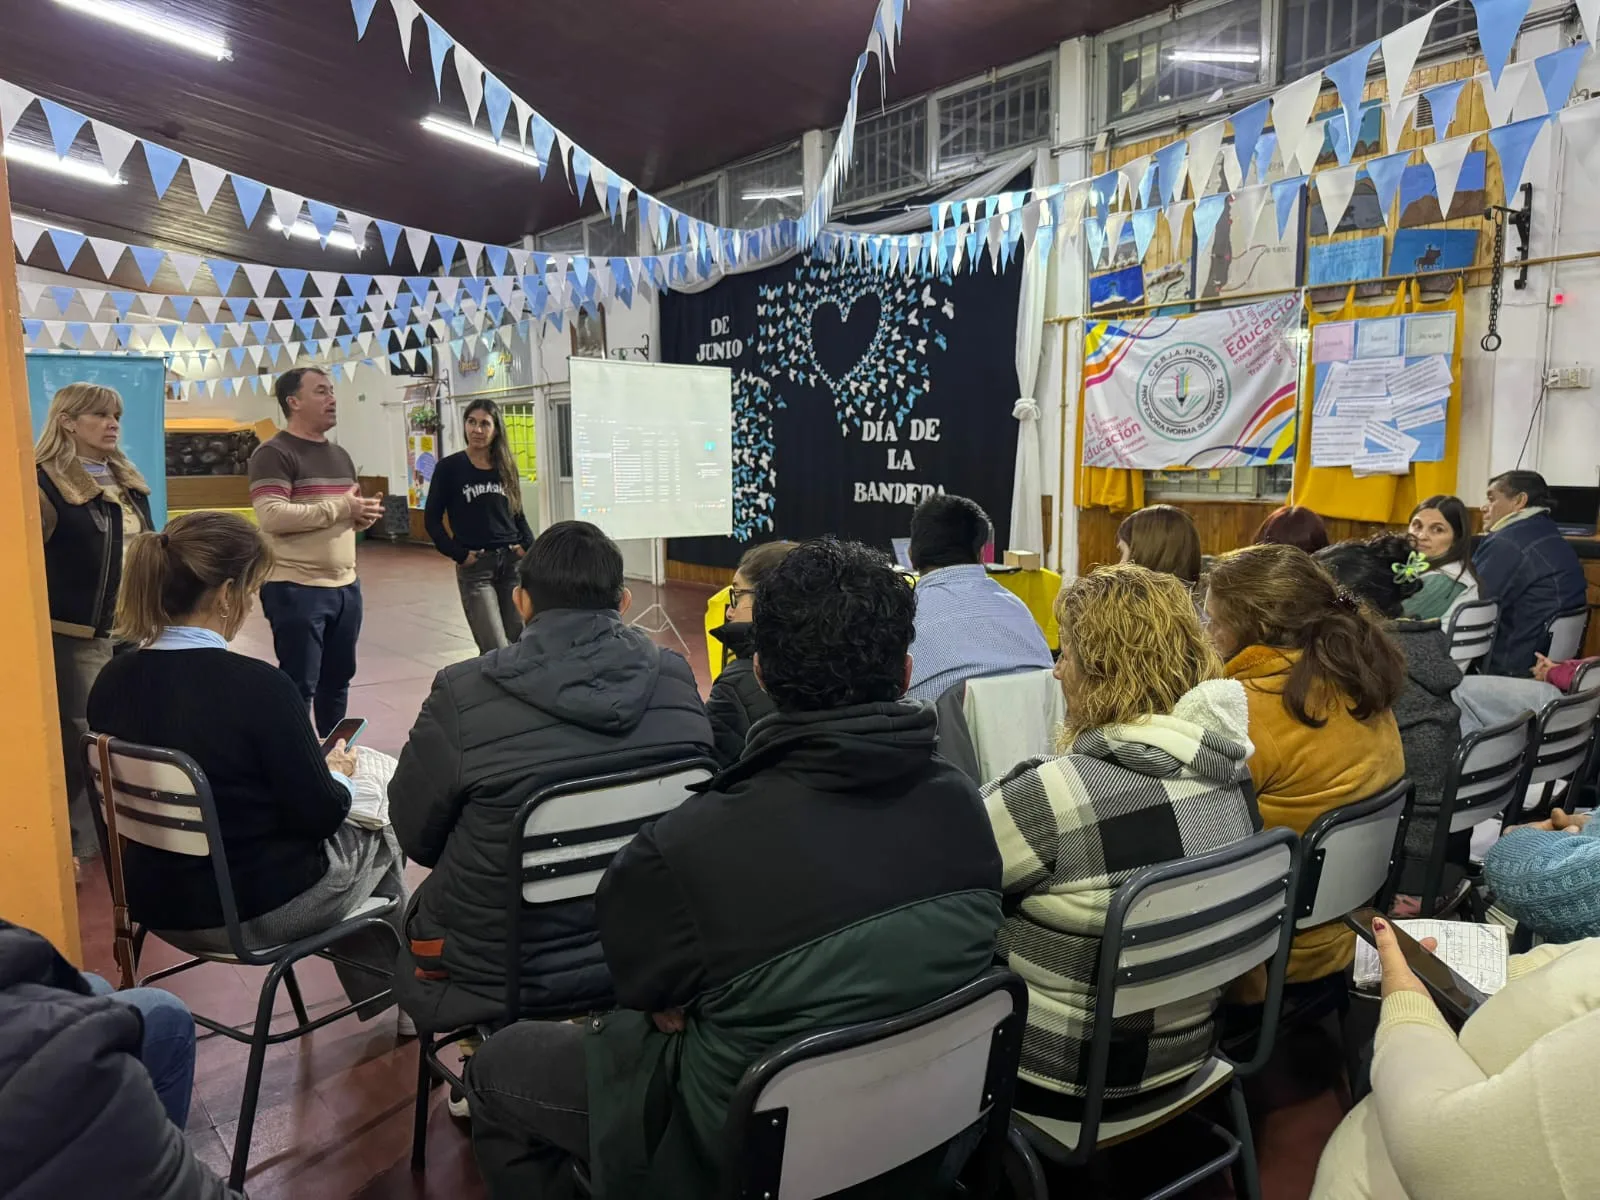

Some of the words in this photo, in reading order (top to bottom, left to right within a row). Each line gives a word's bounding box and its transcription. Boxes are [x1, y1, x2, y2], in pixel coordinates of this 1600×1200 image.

[711, 316, 730, 336] DE
[696, 339, 743, 362] JUNIO
[861, 408, 898, 442] DÍA
[909, 418, 941, 442] DE
[1165, 426, 1197, 435] NORMA
[1197, 400, 1223, 431] SUSANA
[1084, 423, 1142, 464] ducación
[887, 449, 915, 470] LA
